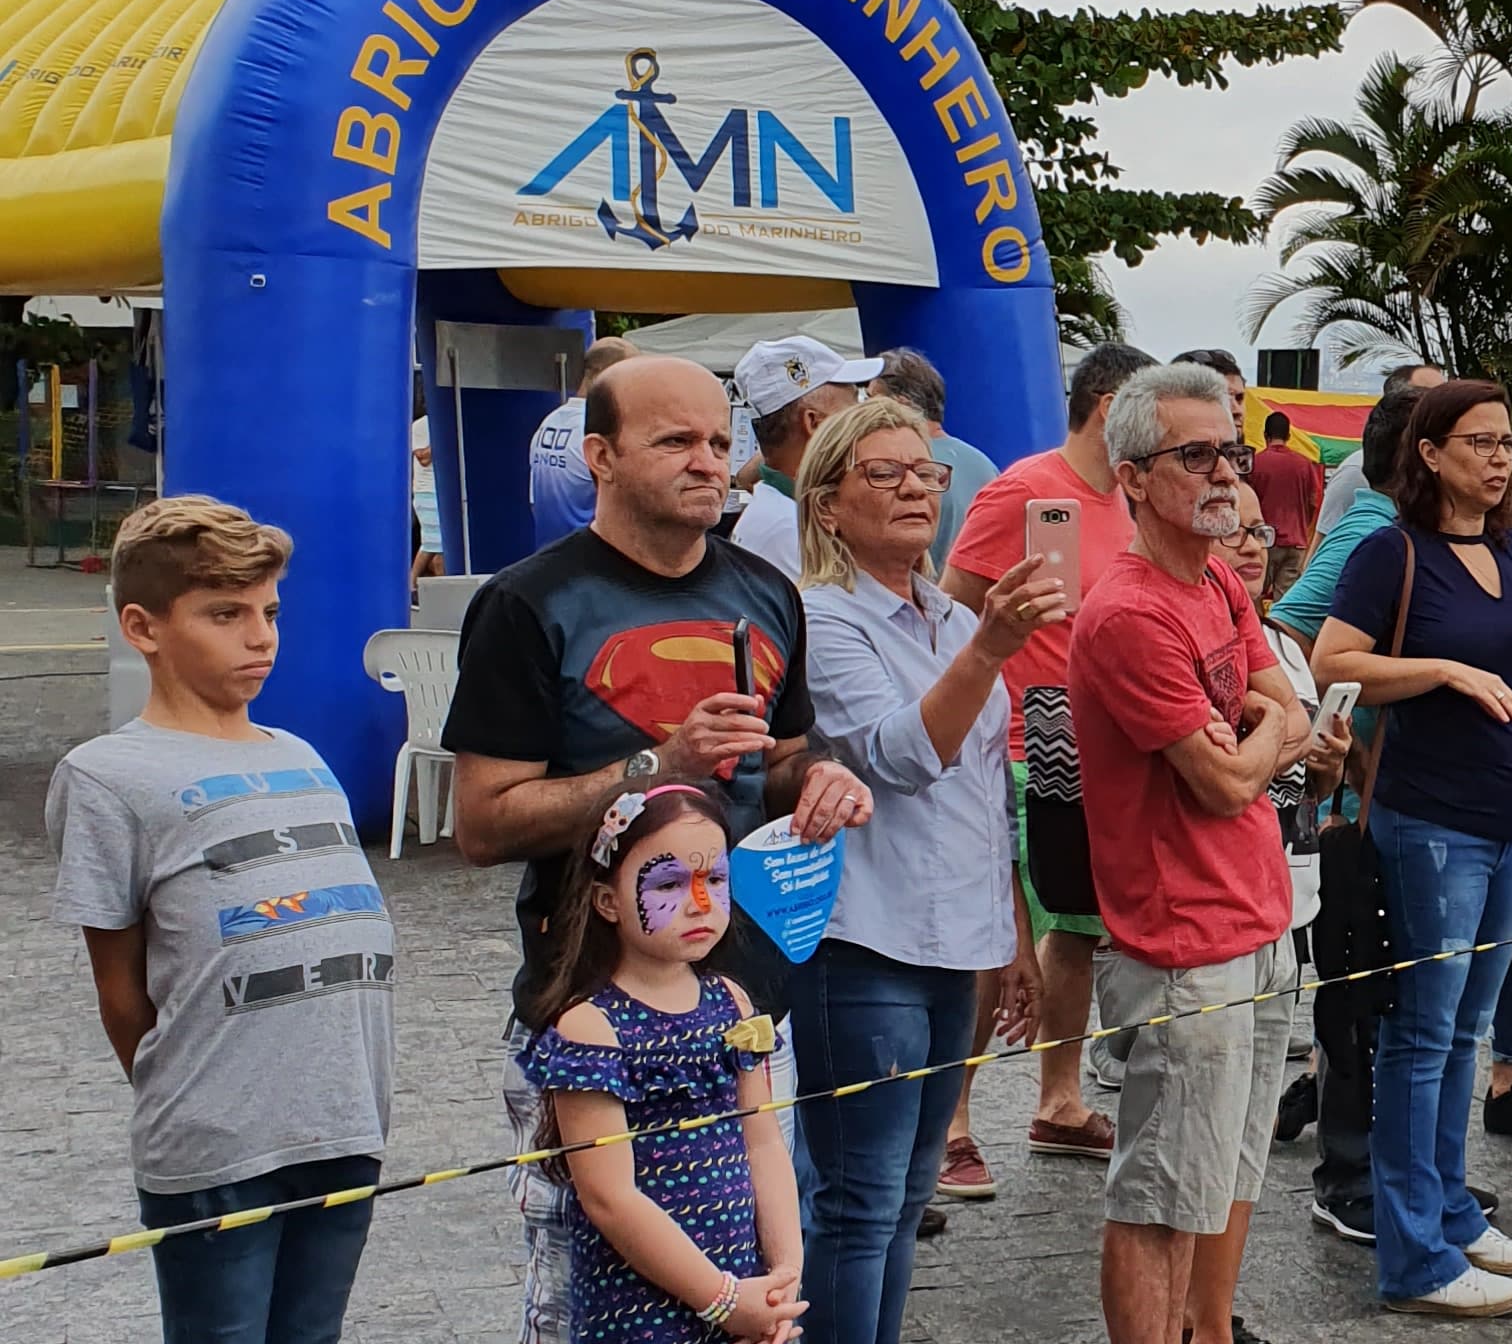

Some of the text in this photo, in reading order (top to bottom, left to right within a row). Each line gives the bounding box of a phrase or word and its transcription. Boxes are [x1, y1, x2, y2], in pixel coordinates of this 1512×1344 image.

[514, 102, 856, 214] AMN
[512, 209, 599, 228] ABRIGO
[738, 222, 863, 244] MARINHEIRO
[535, 426, 573, 451] 100
